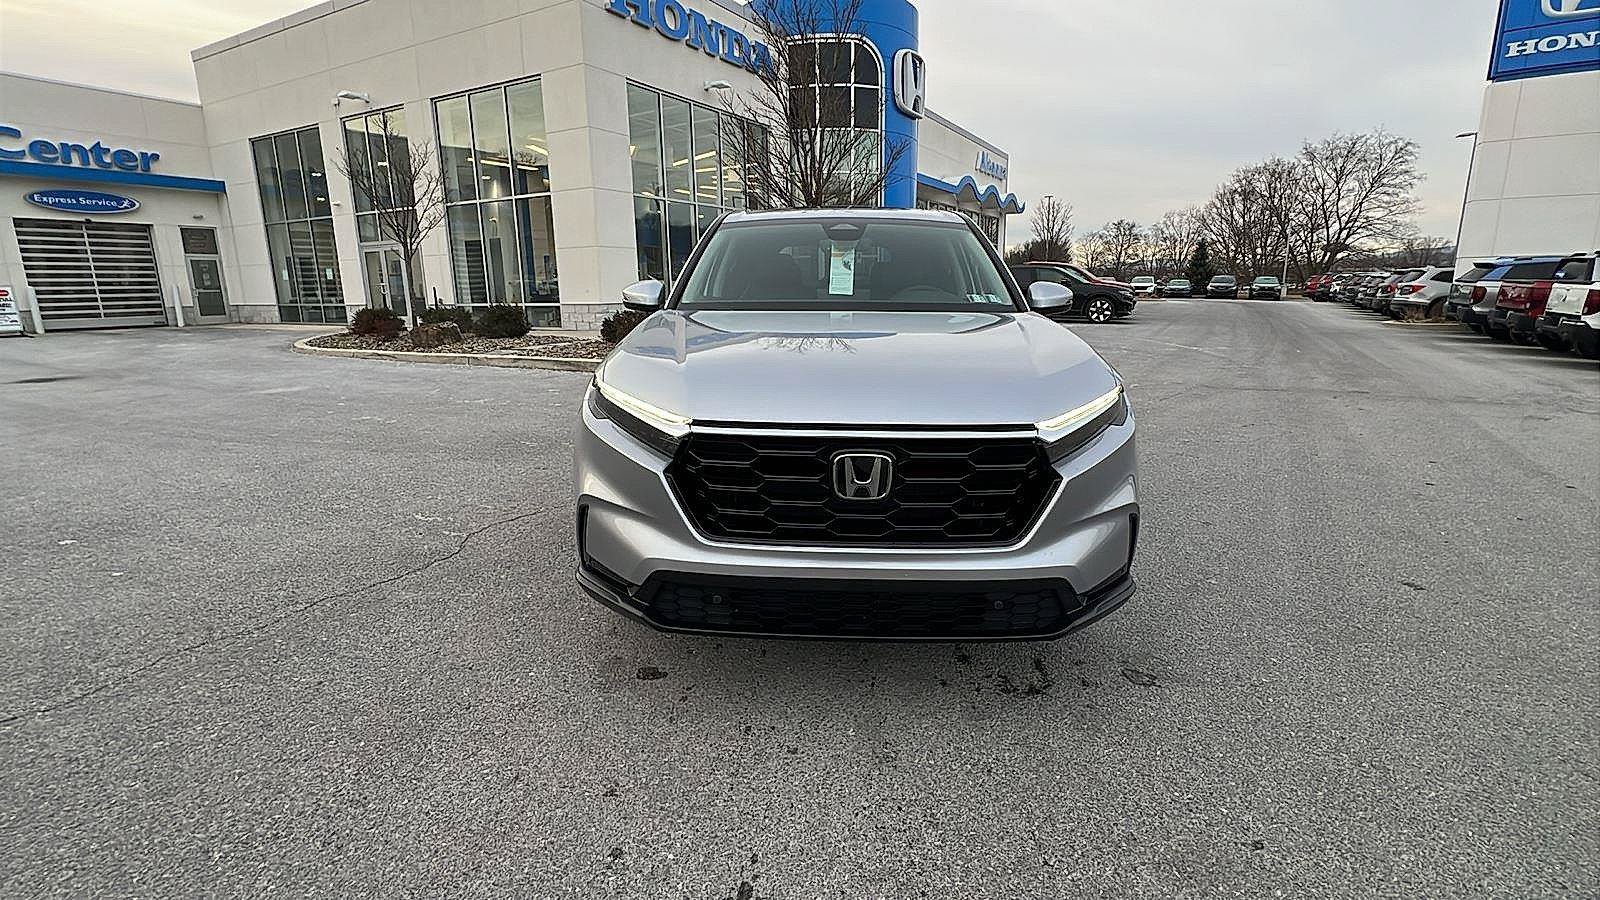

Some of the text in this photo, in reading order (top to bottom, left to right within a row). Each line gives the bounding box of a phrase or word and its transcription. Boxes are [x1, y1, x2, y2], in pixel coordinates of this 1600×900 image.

[1505, 31, 1600, 58] HON
[33, 194, 118, 207] Express Service
